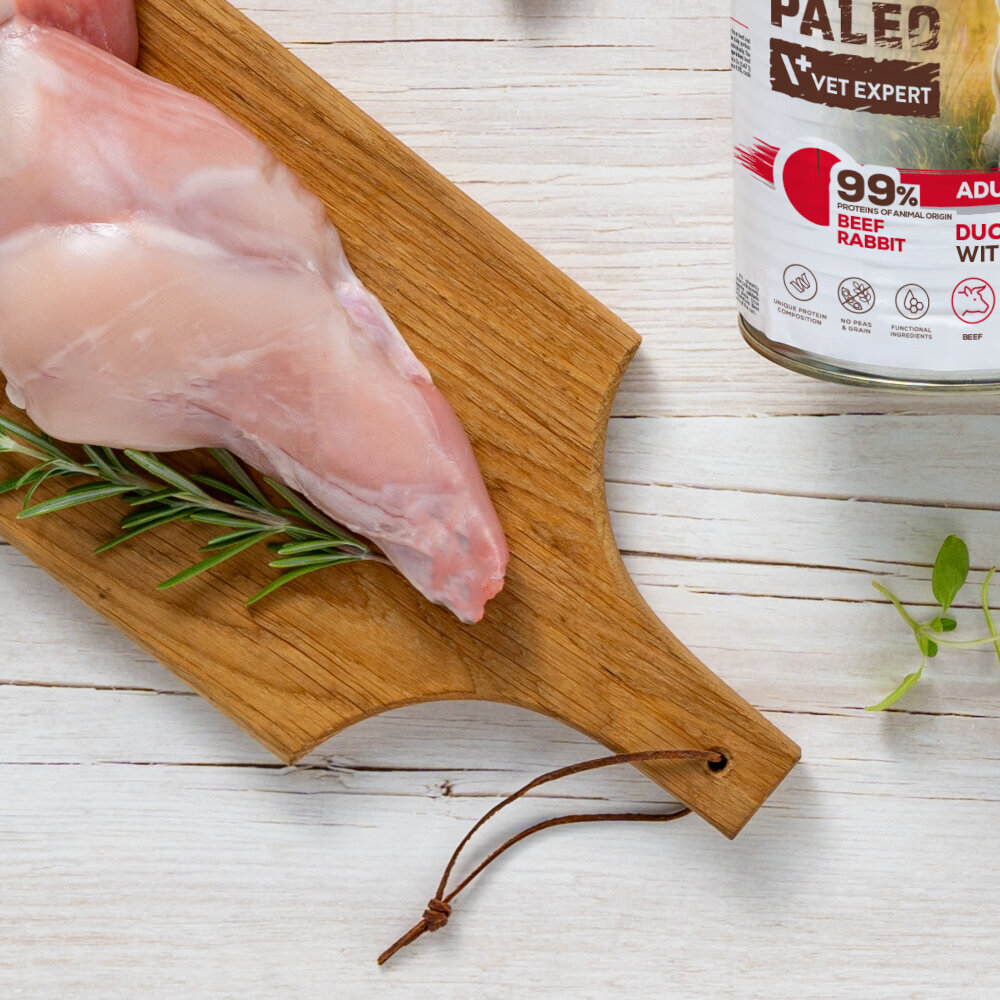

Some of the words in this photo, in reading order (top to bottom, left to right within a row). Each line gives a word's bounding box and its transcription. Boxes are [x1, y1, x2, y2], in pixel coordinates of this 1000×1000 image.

[811, 72, 849, 96] VET
[854, 80, 932, 104] EXPERT
[837, 169, 918, 207] 99%
[837, 202, 879, 215] PROTEINS
[880, 208, 892, 216] OF
[893, 210, 925, 219] ANIMAL
[926, 212, 953, 221] ORIGIN
[838, 213, 885, 233] BEEF
[837, 230, 906, 252] RABBIT
[773, 298, 797, 313] UNIQUE
[798, 307, 828, 320] PROTEIN
[777, 307, 822, 326] COMPOSITION
[840, 317, 852, 325] NO
[853, 319, 873, 328] PEAS
[848, 325, 872, 335] GRAIN
[890, 324, 932, 333] FUNCTIONAL
[890, 331, 933, 340] INGREDIENTS
[962, 333, 983, 341] BEEF
